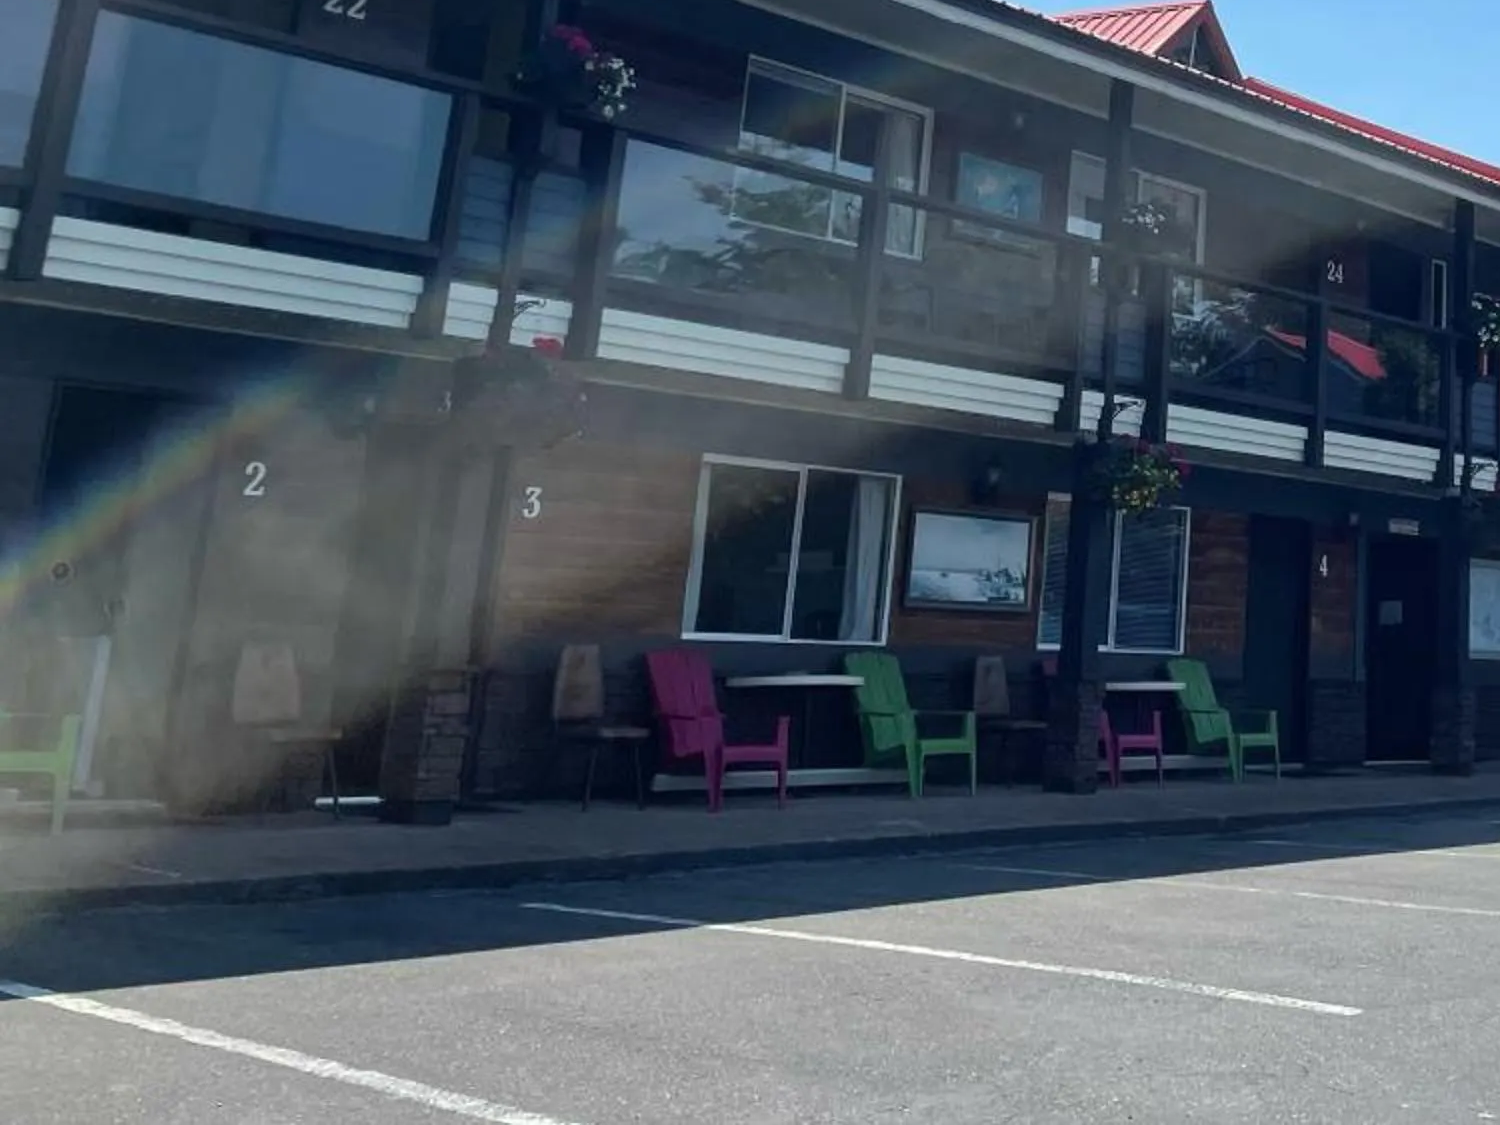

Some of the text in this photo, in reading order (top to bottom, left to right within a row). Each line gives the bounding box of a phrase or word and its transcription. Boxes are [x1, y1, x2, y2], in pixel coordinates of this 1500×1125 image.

[1327, 260, 1343, 283] 24
[243, 461, 266, 496] 2
[523, 486, 542, 518] 3
[1319, 554, 1329, 577] 4
